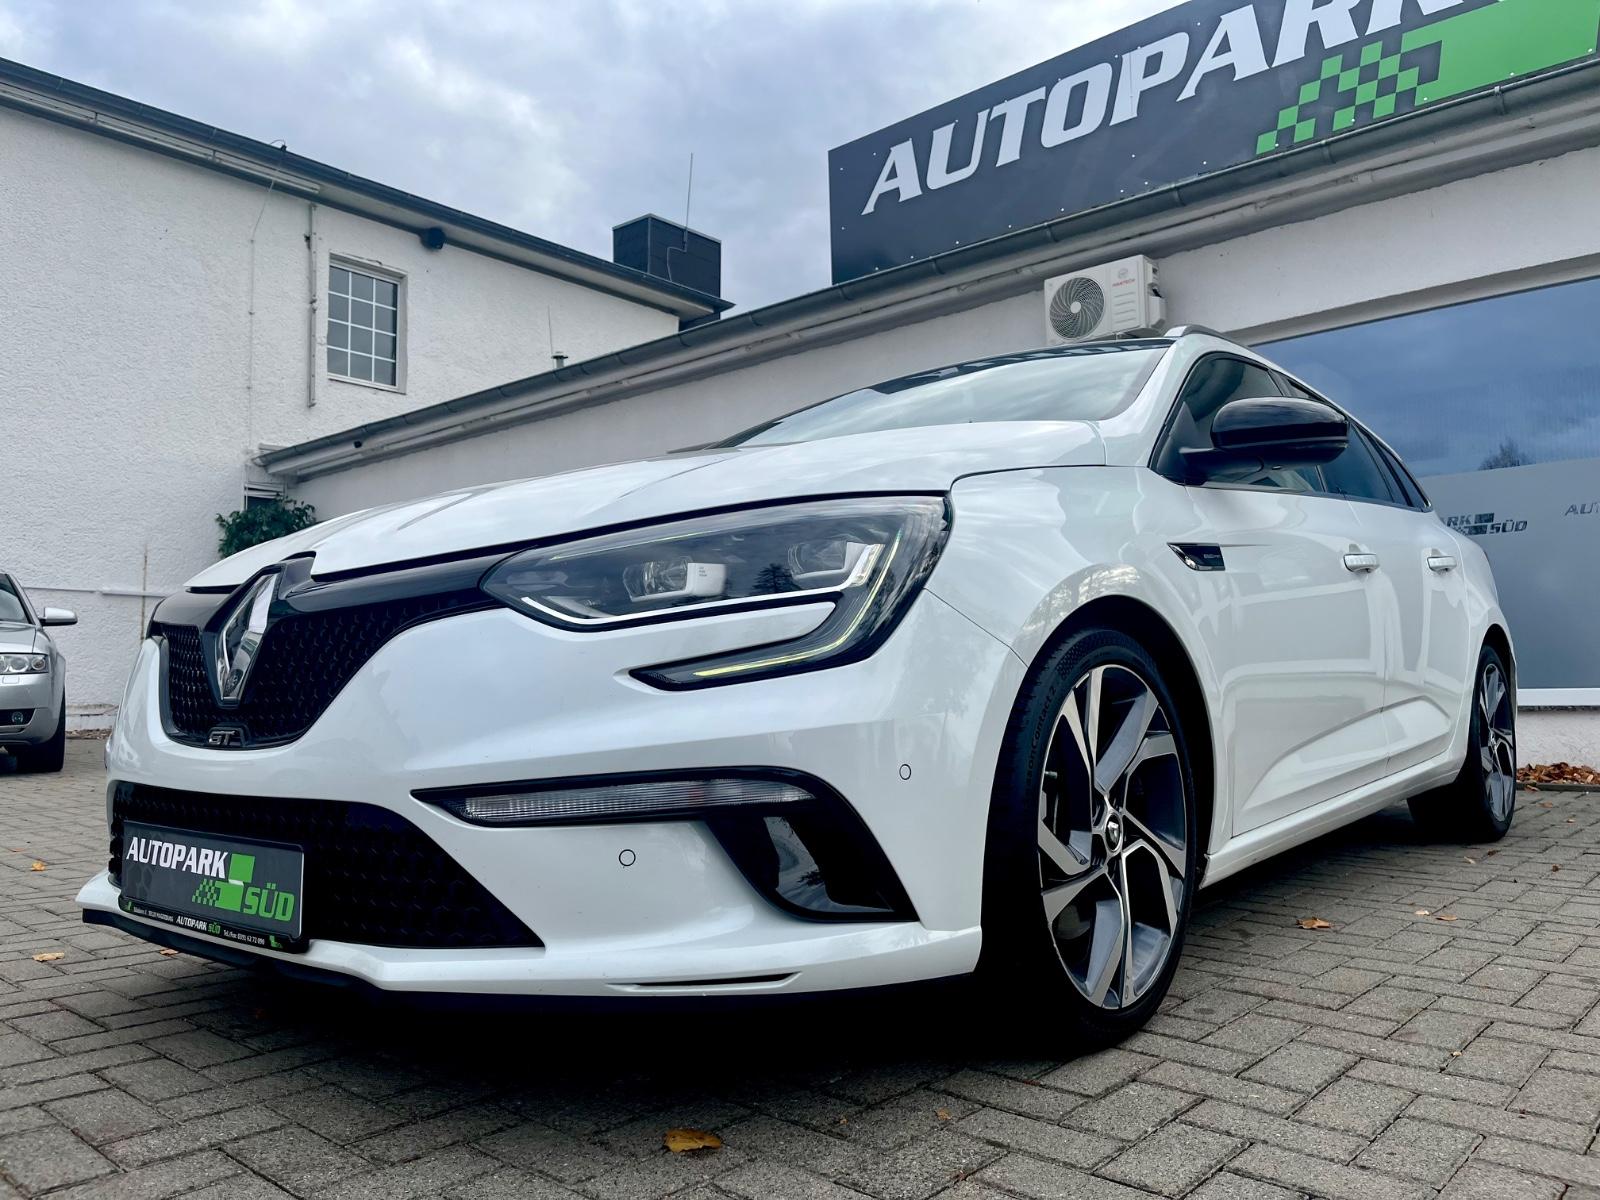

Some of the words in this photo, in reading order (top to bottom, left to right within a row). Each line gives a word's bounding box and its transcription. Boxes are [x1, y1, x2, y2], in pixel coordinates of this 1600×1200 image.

[861, 0, 1464, 216] AUTOPAR
[1490, 519, 1528, 534] SÜD
[208, 730, 236, 746] GT
[126, 836, 229, 879] AUTOPARK
[243, 882, 295, 922] SÜD
[175, 915, 208, 931] AUTOPARK
